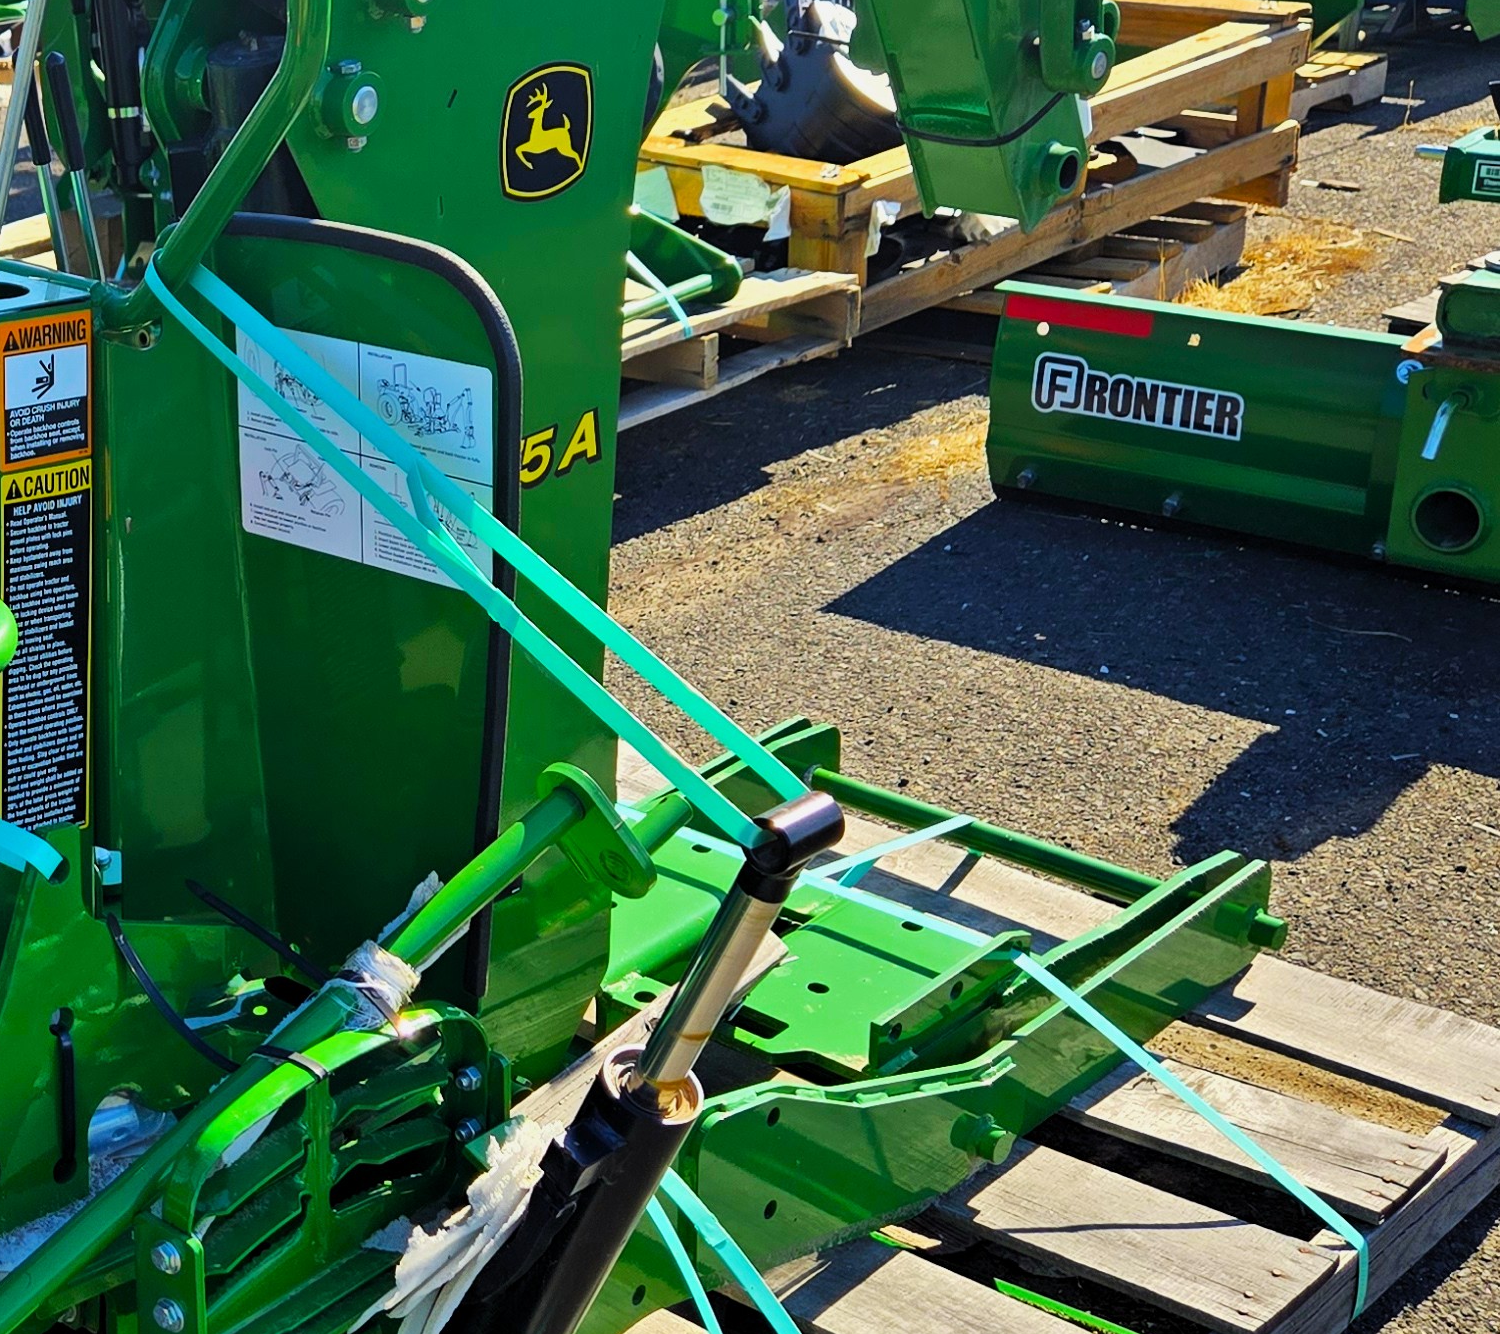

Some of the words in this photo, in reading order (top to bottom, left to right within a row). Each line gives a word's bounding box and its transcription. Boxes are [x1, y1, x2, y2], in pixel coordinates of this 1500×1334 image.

[18, 318, 87, 350] WARNING
[10, 408, 31, 419] AVOID
[32, 404, 56, 415] CRUSH
[57, 400, 80, 410] INJURY
[1034, 354, 1241, 437] FRONTIER
[10, 420, 21, 428] OR
[22, 415, 45, 426] DEATH
[520, 425, 556, 485] 5
[556, 409, 599, 474] A
[23, 465, 90, 498] CAUTION
[13, 505, 32, 516] HELP
[34, 500, 55, 513] AVOID
[57, 495, 82, 509] INJURY
